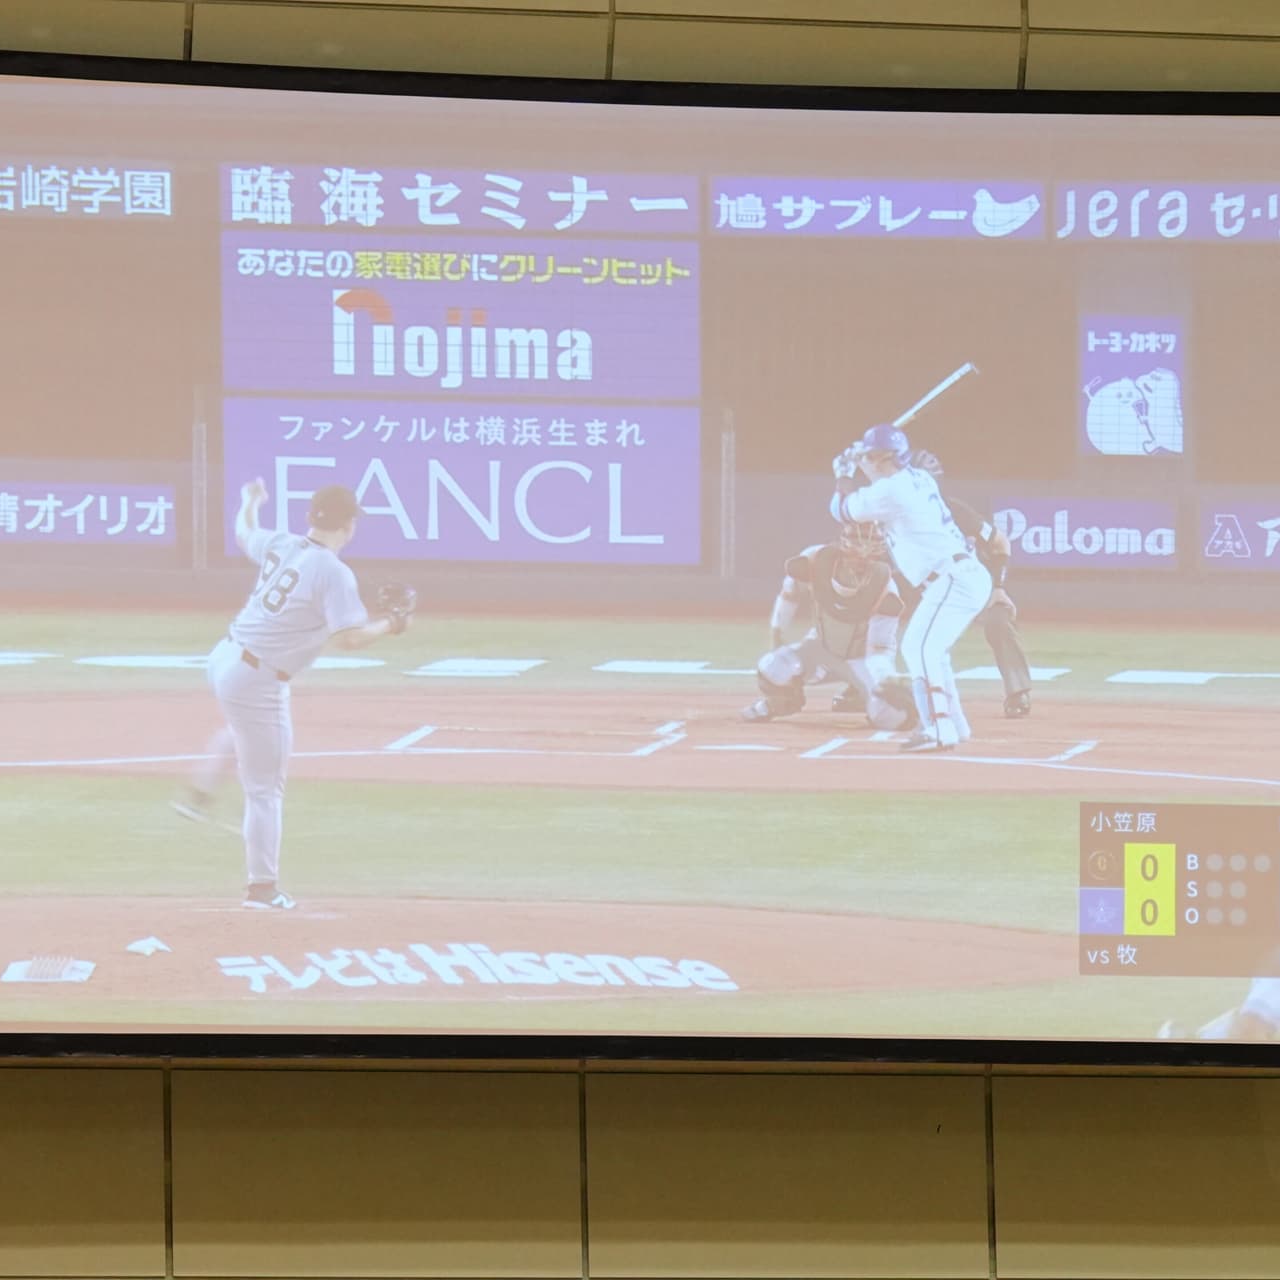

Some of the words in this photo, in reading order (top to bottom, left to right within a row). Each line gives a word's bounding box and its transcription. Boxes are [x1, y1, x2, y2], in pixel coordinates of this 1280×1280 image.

[231, 166, 689, 230] 臨海セミナー
[714, 192, 968, 232] 鳩サブレー
[236, 248, 691, 286] あなたの家電選びにクリーンヒット
[1087, 330, 1177, 354] トーヨーカネツ
[278, 415, 645, 448] ファンケルは横浜生まれ
[274, 455, 666, 545] FANCL
[993, 508, 1176, 556] Paloma
[1090, 812, 1157, 834] 小笠原
[1140, 854, 1158, 881] 0
[1186, 854, 1199, 870] B
[1186, 882, 1198, 898] S
[1140, 899, 1158, 926] 0
[1087, 951, 1110, 964] vs
[1116, 943, 1137, 965] 牧
